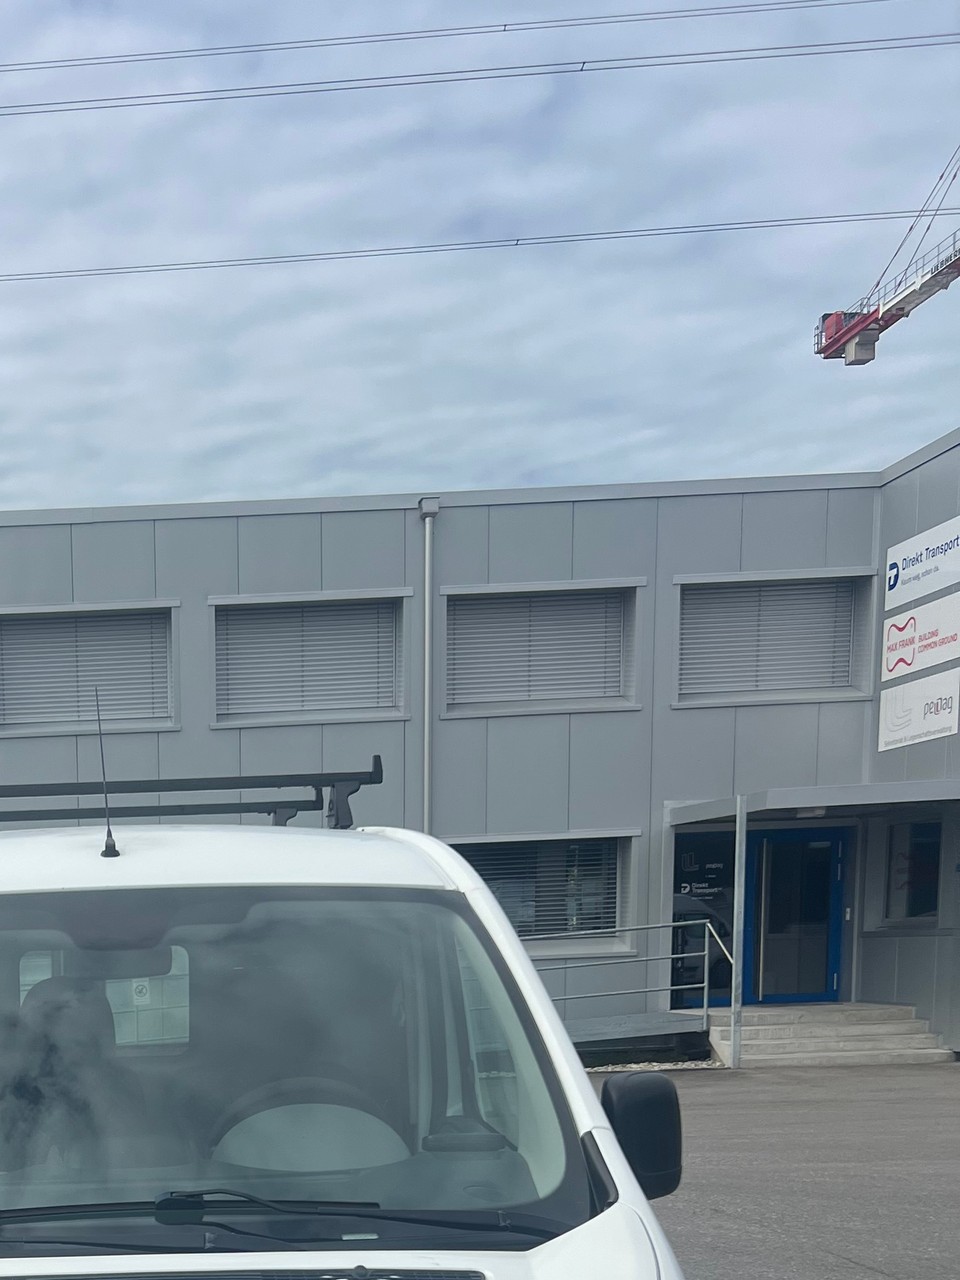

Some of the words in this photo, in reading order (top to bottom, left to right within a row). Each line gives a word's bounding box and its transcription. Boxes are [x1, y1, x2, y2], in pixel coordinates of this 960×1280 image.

[901, 551, 924, 571] Direkt
[924, 534, 960, 561] Transport
[887, 641, 898, 653] MAX
[898, 636, 915, 650] FRANK
[917, 641, 938, 654] COMMON
[938, 633, 958, 647] GROUND
[918, 629, 939, 643] BUILDING
